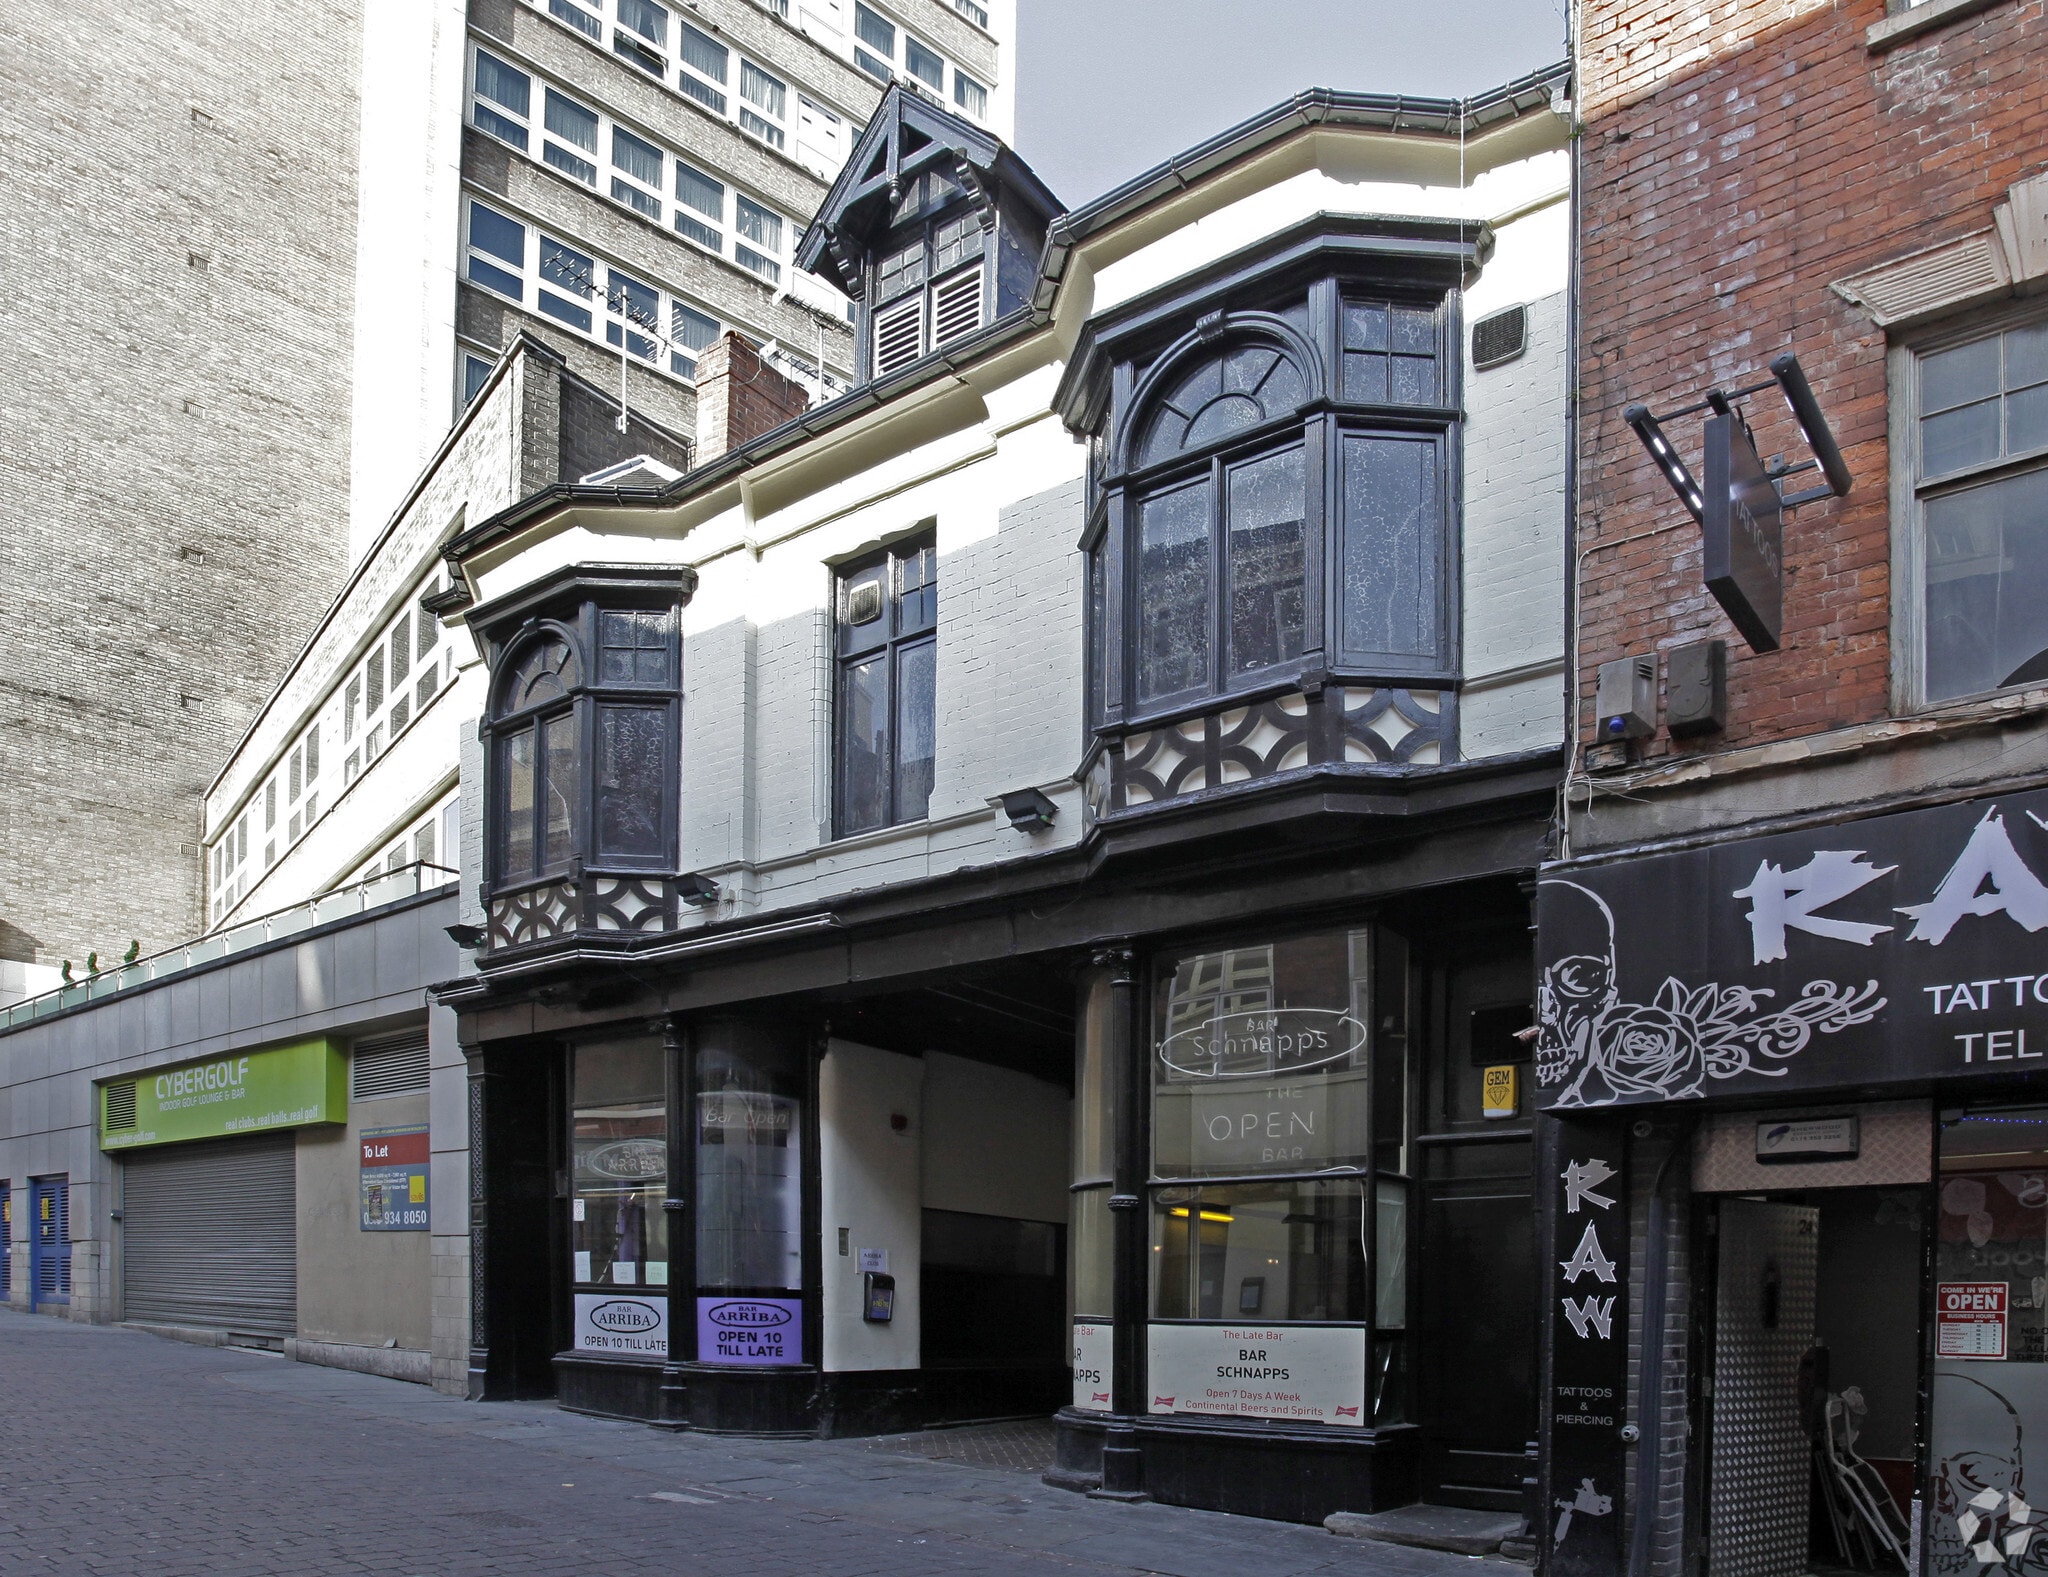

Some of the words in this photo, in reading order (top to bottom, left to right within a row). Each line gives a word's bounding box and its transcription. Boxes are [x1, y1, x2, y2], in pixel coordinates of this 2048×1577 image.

[1737, 499, 1778, 578] TATTOOS
[1732, 804, 2048, 966] RA
[1954, 1029, 2043, 1064] TEL
[156, 1057, 249, 1099] CYBERGOLF
[1486, 1070, 1511, 1086] GEM
[159, 1099, 181, 1112] INDOOR
[182, 1096, 198, 1108] GOLF
[199, 1091, 223, 1105] LOUNGE
[231, 1087, 246, 1100] BAR
[304, 1104, 319, 1122] golf
[1209, 1111, 1315, 1141] OPEN
[363, 1145, 373, 1158] To
[375, 1144, 389, 1158] Let
[1262, 1147, 1304, 1163] BAR
[384, 1211, 401, 1225] 934
[403, 1210, 427, 1225] 8050
[1946, 1293, 1998, 1310] OPEN
[616, 1305, 632, 1313] BAR
[598, 1312, 652, 1326] ARRIBA
[716, 1311, 781, 1322] ARRIBA
[718, 1330, 758, 1343] OPEN
[763, 1332, 782, 1344] 10
[1081, 1326, 1095, 1336] Bar
[1223, 1330, 1240, 1340] The
[1242, 1331, 1264, 1340] Late
[1266, 1331, 1284, 1341] Bar
[2021, 1327, 2038, 1335] NO
[584, 1335, 609, 1347] OPEN
[611, 1337, 623, 1348] 10
[624, 1338, 643, 1350] TILL
[644, 1339, 667, 1352] LATE
[716, 1344, 743, 1356] TILL
[748, 1345, 784, 1357] LATE
[1239, 1349, 1267, 1361] BAR
[1217, 1366, 1290, 1380] SCHNAPPS
[1206, 1388, 1230, 1398] Open
[1232, 1390, 1238, 1398] 7
[1240, 1390, 1263, 1401] Days
[1265, 1391, 1272, 1400] A
[1274, 1391, 1301, 1401] Week
[1557, 1386, 1613, 1398] TATTOOS
[1185, 1400, 1238, 1411] Continental
[1240, 1402, 1269, 1413] Beers
[1271, 1404, 1289, 1414] and
[1291, 1406, 1324, 1417] Spirits
[1579, 1401, 1588, 1411] &
[1556, 1414, 1613, 1426] PIERCING
